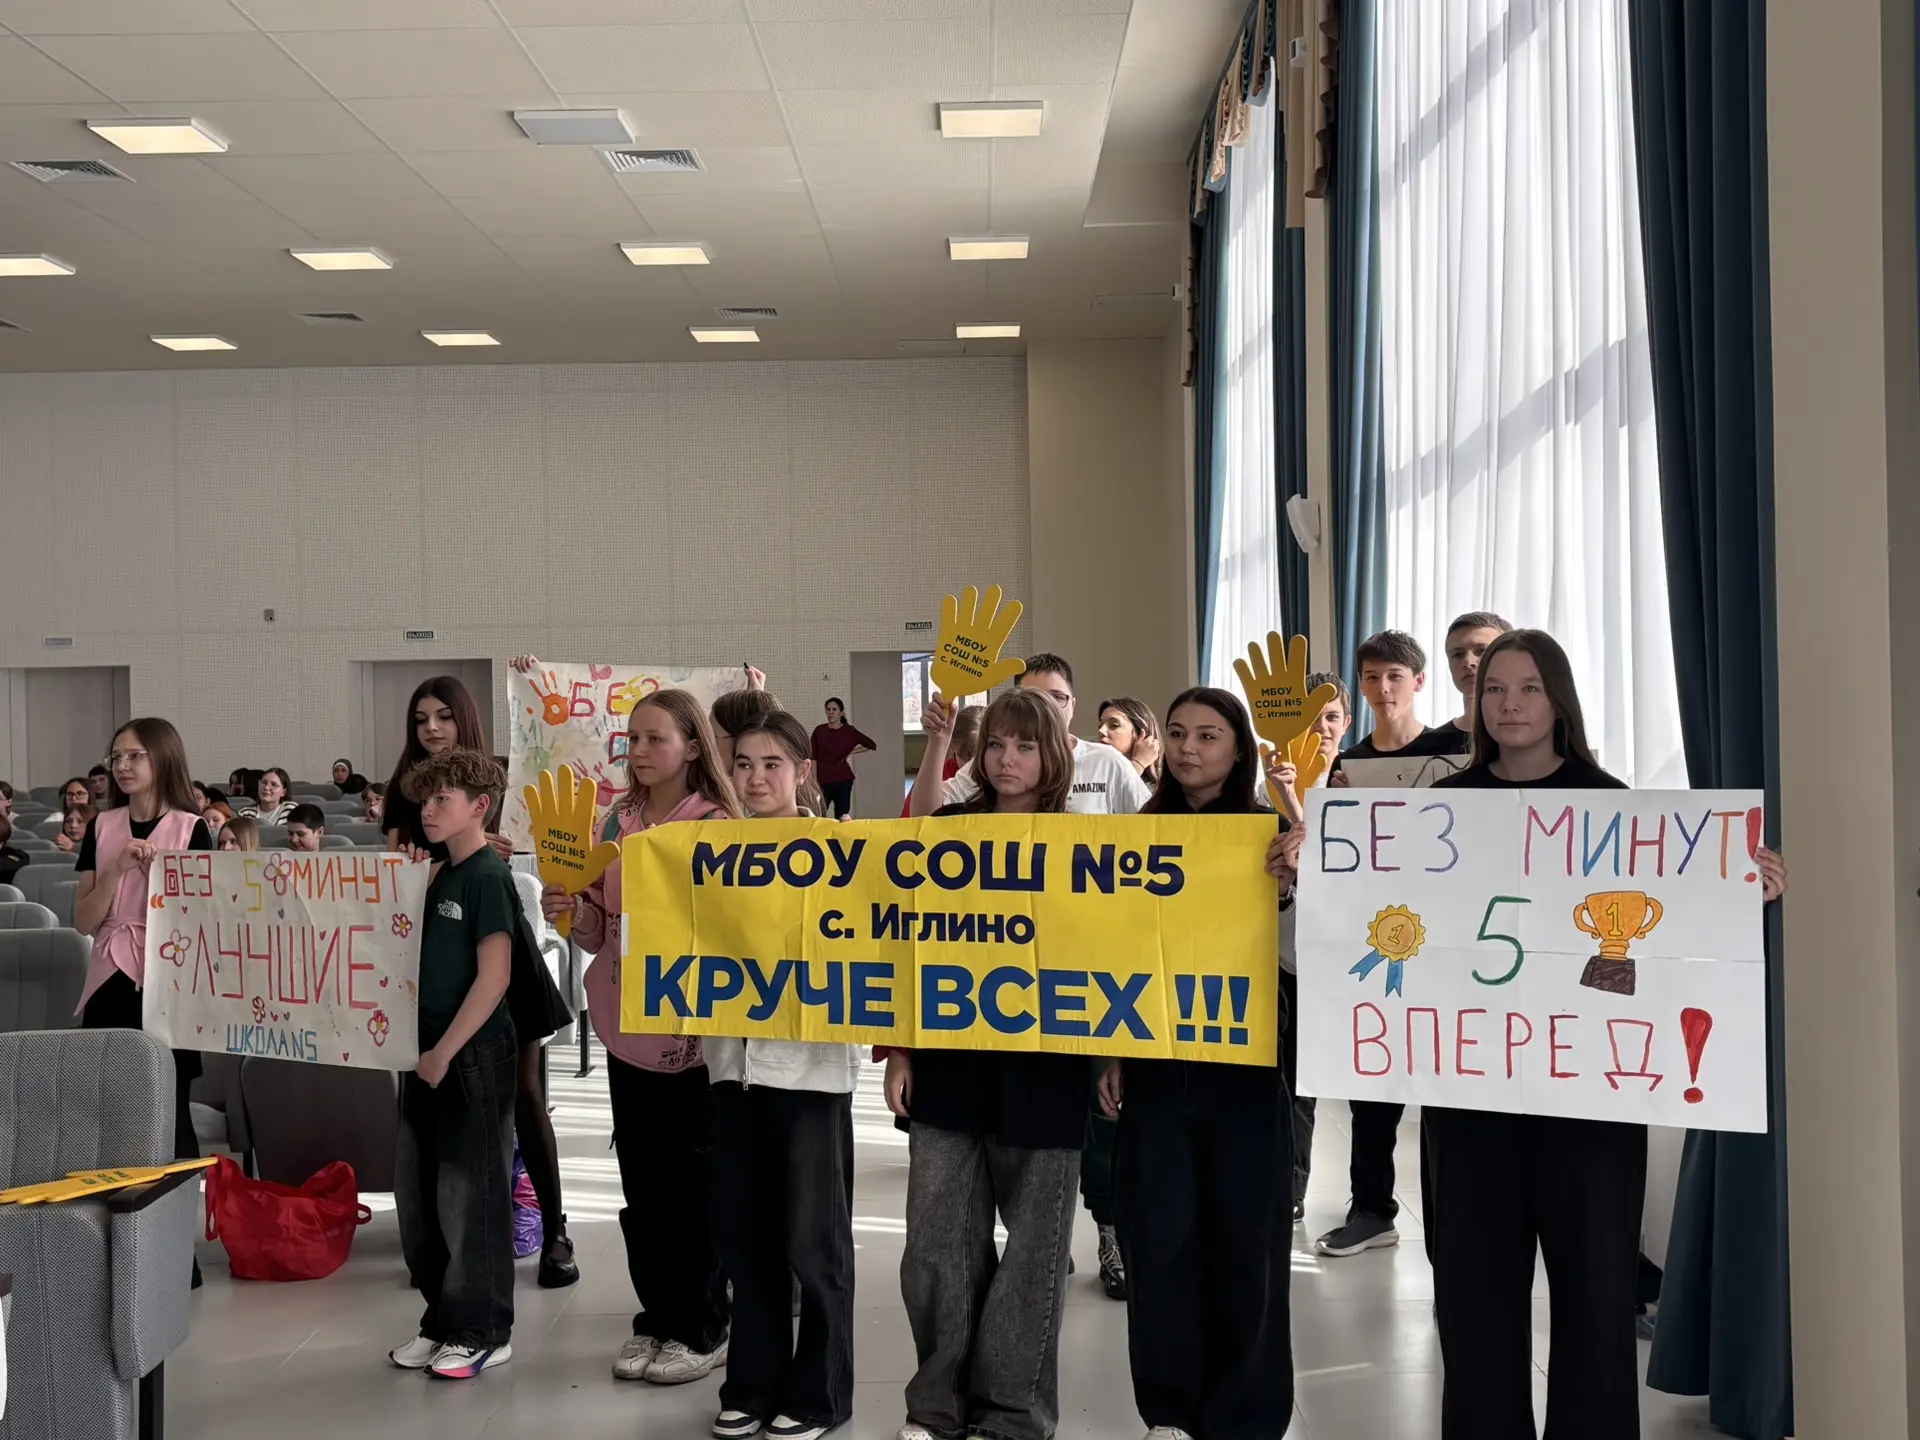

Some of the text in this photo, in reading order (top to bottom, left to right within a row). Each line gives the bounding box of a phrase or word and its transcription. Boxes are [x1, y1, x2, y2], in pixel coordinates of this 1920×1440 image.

[955, 634, 988, 653] МБОУ
[943, 643, 990, 668] СОШ №5
[949, 658, 983, 678] Иглино
[1261, 686, 1292, 697] МБОУ
[1255, 697, 1302, 709] СОШ №5
[1267, 710, 1302, 719] Иглино
[548, 828, 578, 843] МБОУ
[1320, 800, 1762, 883] БЕЗ МИНУТ!
[541, 840, 586, 859] СОШ №5
[551, 855, 585, 871] Иглино
[692, 838, 1186, 897] МБОУ СОШ №5
[164, 854, 403, 912] БЕЗ 5 МИНУТ
[819, 902, 1036, 945] с. Иглино
[1471, 895, 1532, 986] 5
[192, 922, 379, 1010] ЛУЧШИЕ
[643, 954, 895, 1028] КРУЧЕ
[921, 963, 1156, 1041] ВСЕХ
